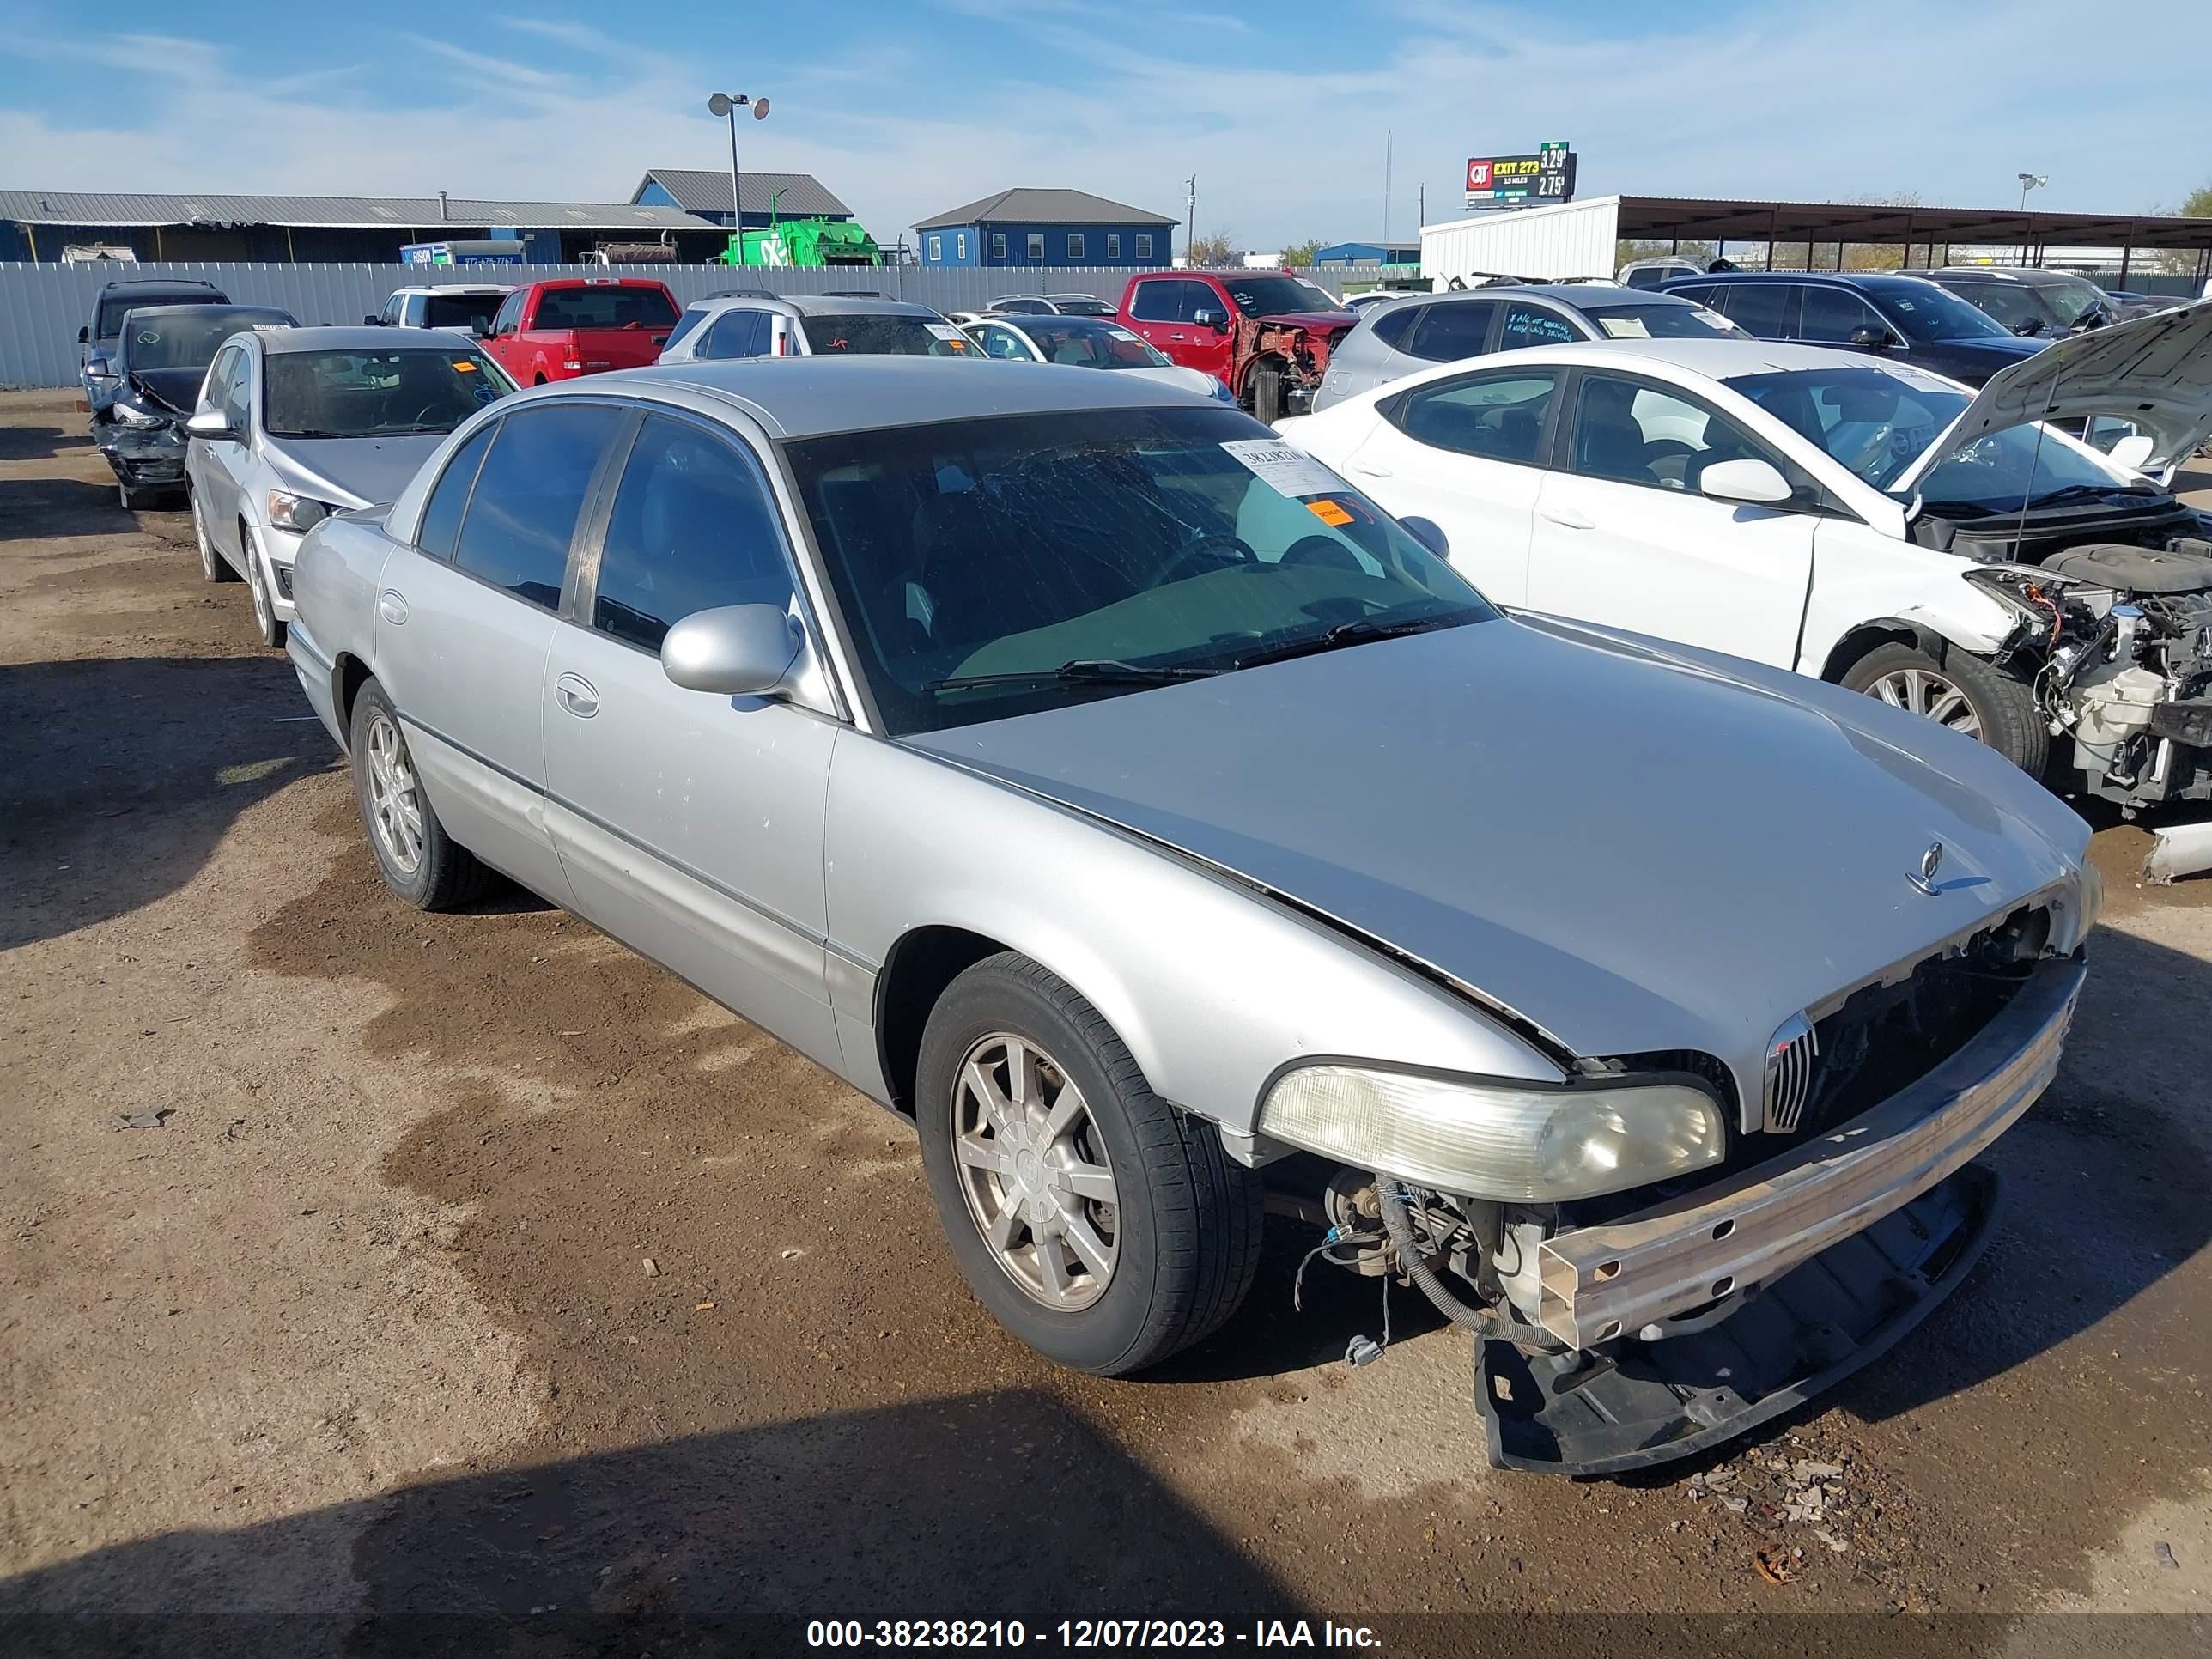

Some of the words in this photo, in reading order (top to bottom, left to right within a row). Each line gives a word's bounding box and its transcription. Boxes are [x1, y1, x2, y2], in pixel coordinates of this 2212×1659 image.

[1470, 165, 1488, 185] QT
[1494, 162, 1517, 175] EXIT
[1519, 161, 1540, 174] 273
[412, 250, 431, 264] FUSION
[1243, 450, 1304, 465] 38238210
